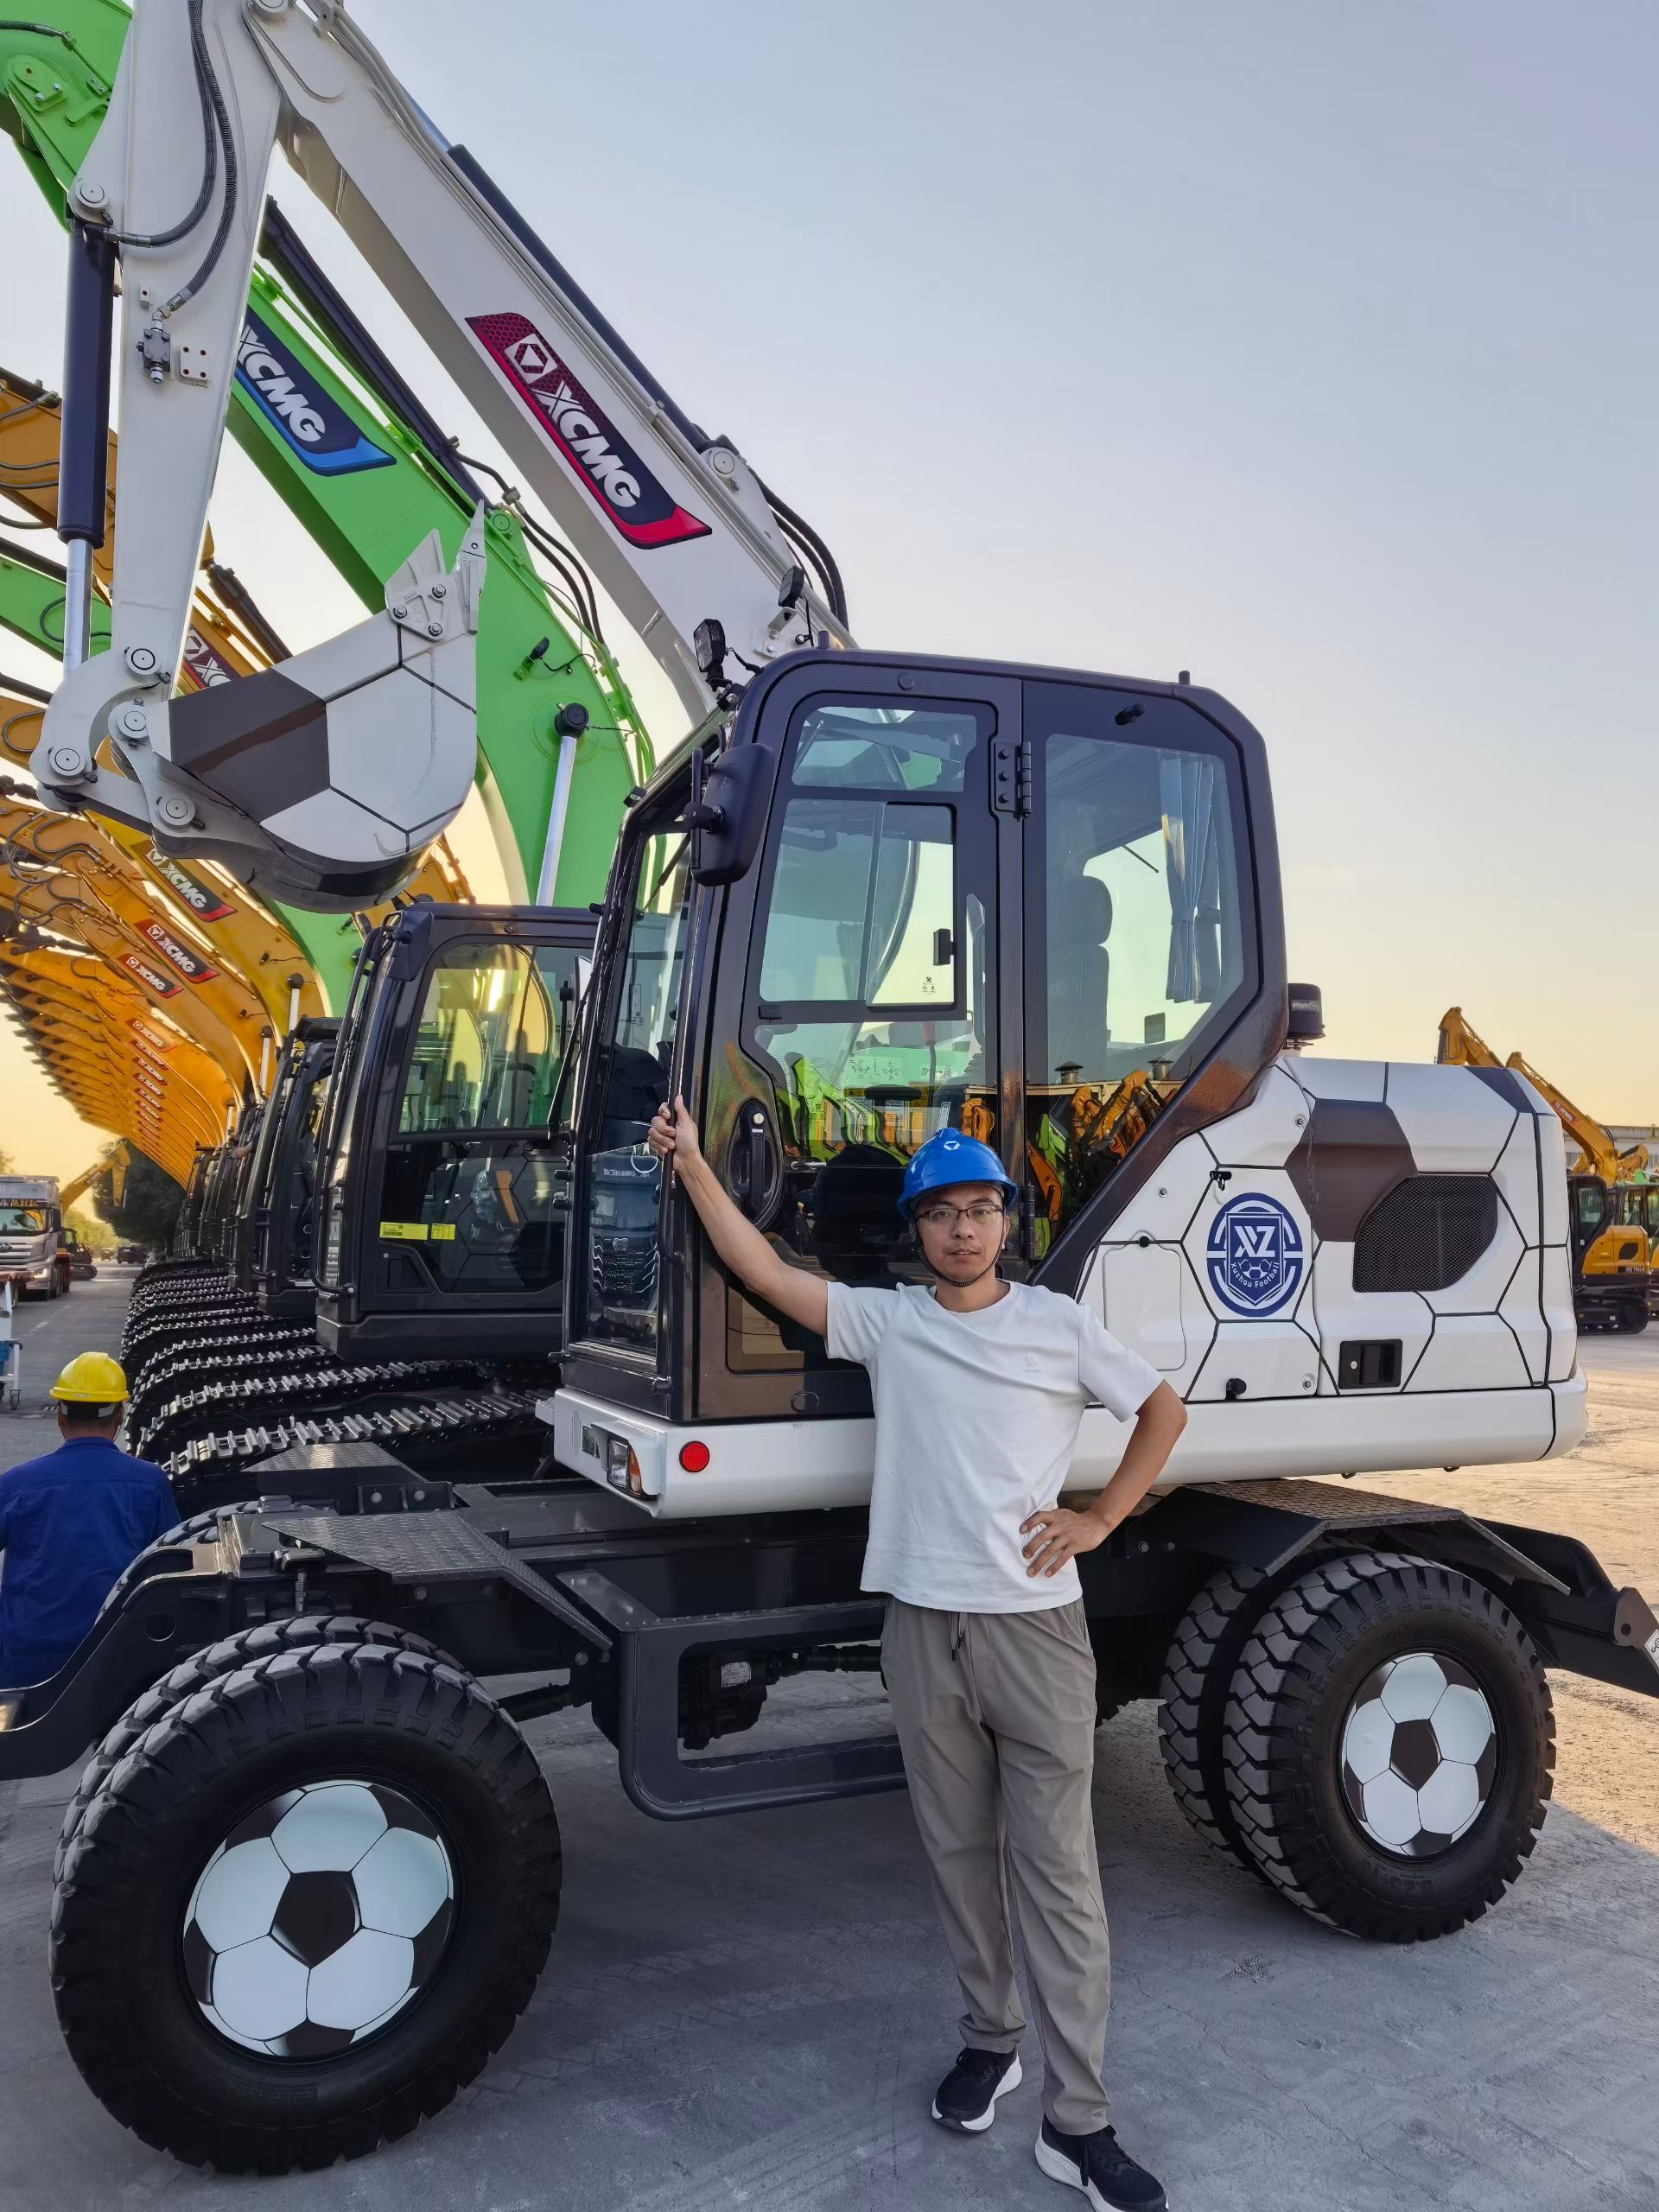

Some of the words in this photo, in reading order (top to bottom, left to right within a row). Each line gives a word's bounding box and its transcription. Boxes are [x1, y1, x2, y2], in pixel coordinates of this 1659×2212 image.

[238, 324, 326, 442] XCMG
[531, 379, 641, 508] XCMG
[158, 861, 207, 908] XCMG
[155, 936, 196, 973] XCMG
[135, 964, 166, 991] XCMG
[1255, 1262, 1281, 1288] Football
